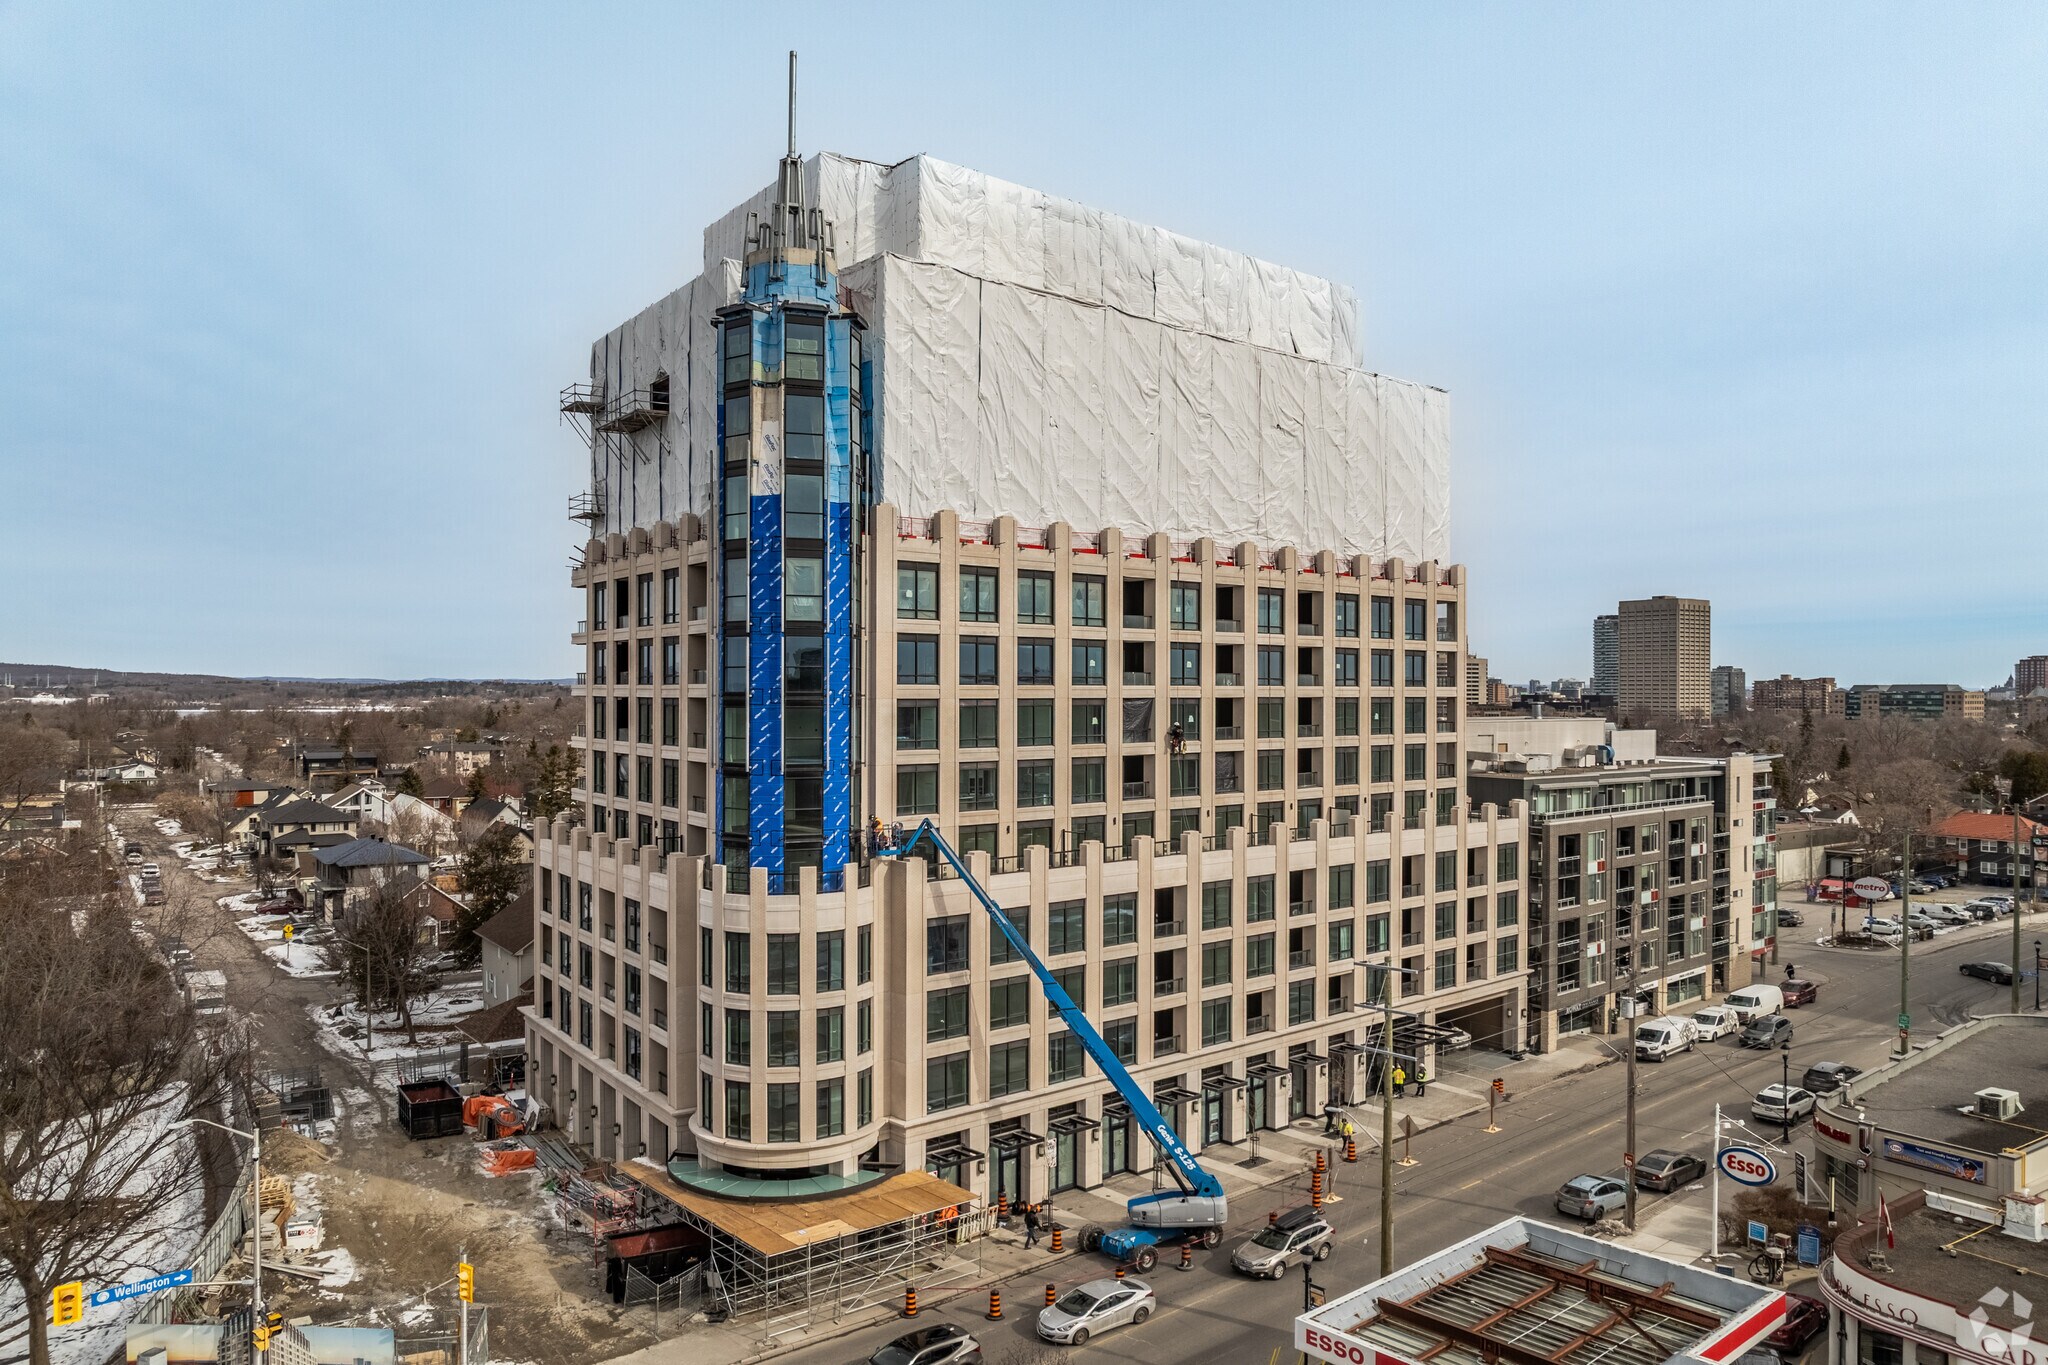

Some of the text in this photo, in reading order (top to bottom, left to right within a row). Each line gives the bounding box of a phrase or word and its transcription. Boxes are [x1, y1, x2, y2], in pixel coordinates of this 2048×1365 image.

[1854, 883, 1886, 892] metro
[1157, 1124, 1197, 1171] Genie S-125
[114, 1277, 170, 1299] Wellington
[1306, 1328, 1365, 1365] ESSO
